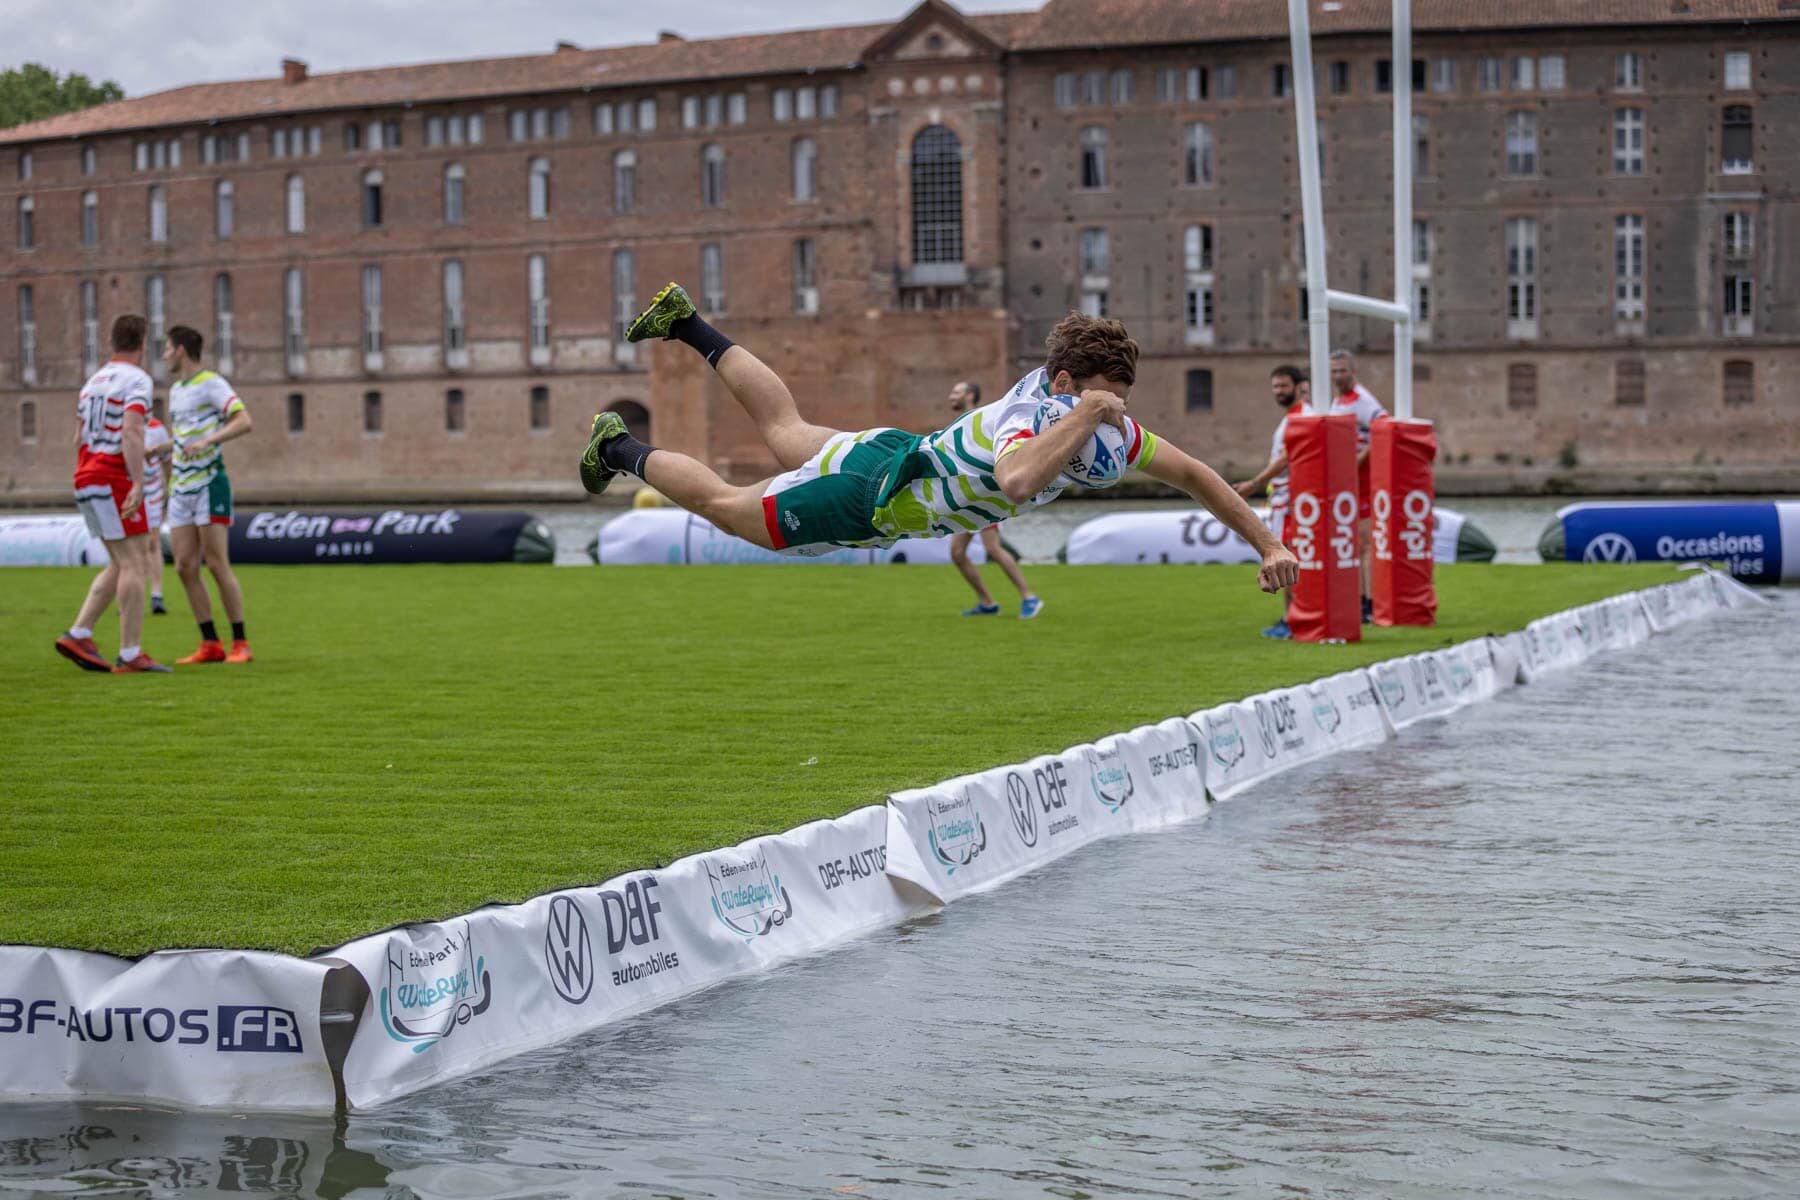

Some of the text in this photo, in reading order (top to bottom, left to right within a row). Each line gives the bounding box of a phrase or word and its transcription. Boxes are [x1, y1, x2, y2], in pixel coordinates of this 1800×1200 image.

[245, 509, 461, 539] Eden Park
[315, 541, 374, 557] PARIS
[1291, 492, 1324, 570] Orpi
[1330, 491, 1360, 568] Orpi
[1372, 489, 1392, 560] Orpi
[1399, 490, 1433, 559] Orpi
[1656, 531, 1764, 559] Occasions
[1033, 761, 1067, 813] DBF
[597, 877, 661, 954] DBF
[429, 937, 458, 966] Park
[612, 952, 679, 986] automobiles
